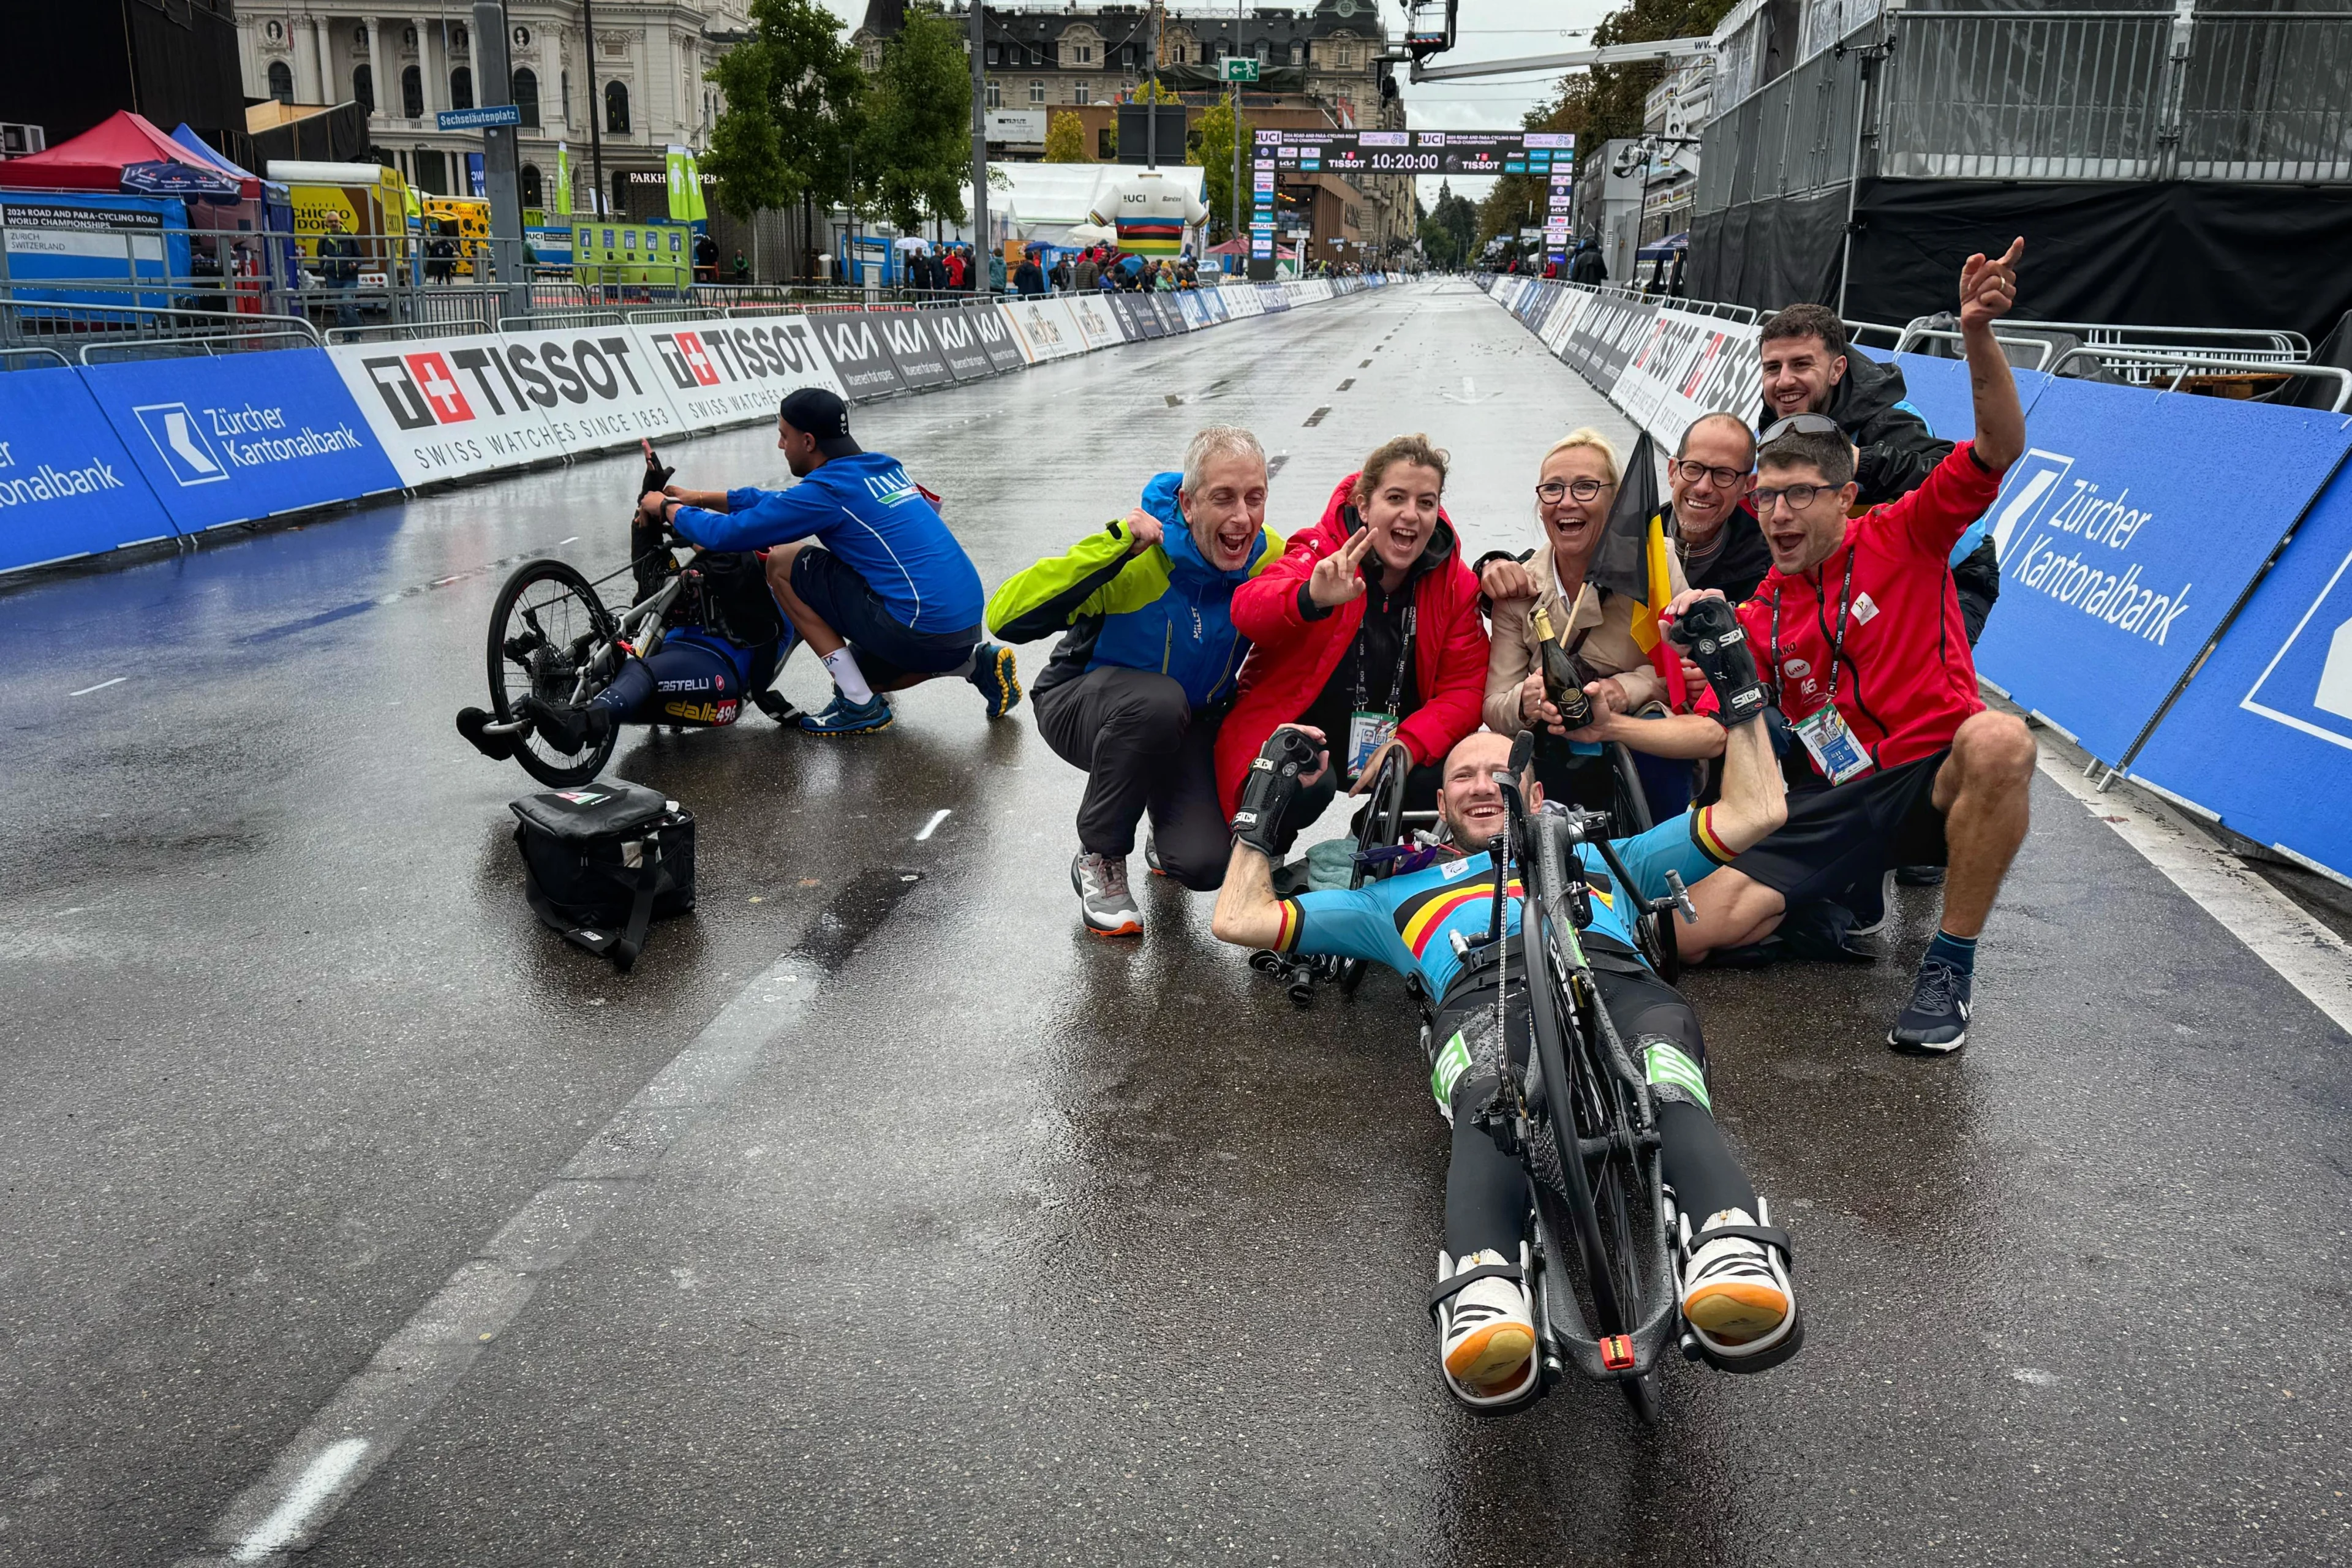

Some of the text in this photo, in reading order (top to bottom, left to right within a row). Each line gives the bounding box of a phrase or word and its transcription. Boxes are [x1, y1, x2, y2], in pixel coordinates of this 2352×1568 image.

[440, 110, 516, 126] Sechseläutenplatz
[1260, 132, 1280, 142] UCI
[1423, 135, 1442, 144] UCI
[1371, 154, 1438, 169] 10:20:00
[630, 173, 666, 183] PARKH
[1128, 194, 1146, 203] UCI
[28, 209, 51, 217] ROAD
[74, 211, 134, 222] PARA-CYCLING
[136, 215, 159, 224] ROAD
[40, 218, 111, 228] CHAMPIONSHIPS
[11, 241, 66, 251] SWITZERLAND
[700, 324, 818, 382] TISSOT
[449, 337, 643, 415] TISSOT
[688, 398, 728, 420] SWISS
[728, 389, 781, 412] WATCHES
[203, 402, 286, 437] Zürcher
[222, 422, 363, 468] Kantonalbank
[414, 407, 669, 469] SWISS WATCHES SINCE 1853
[0, 457, 124, 508] onalbank
[2048, 477, 2152, 551] Zürcher
[2012, 532, 2190, 647] Kantonalbank
[1718, 627, 1744, 647] SIDI
[1732, 687, 1762, 709] SIDI
[1234, 811, 1257, 824] SIDI
